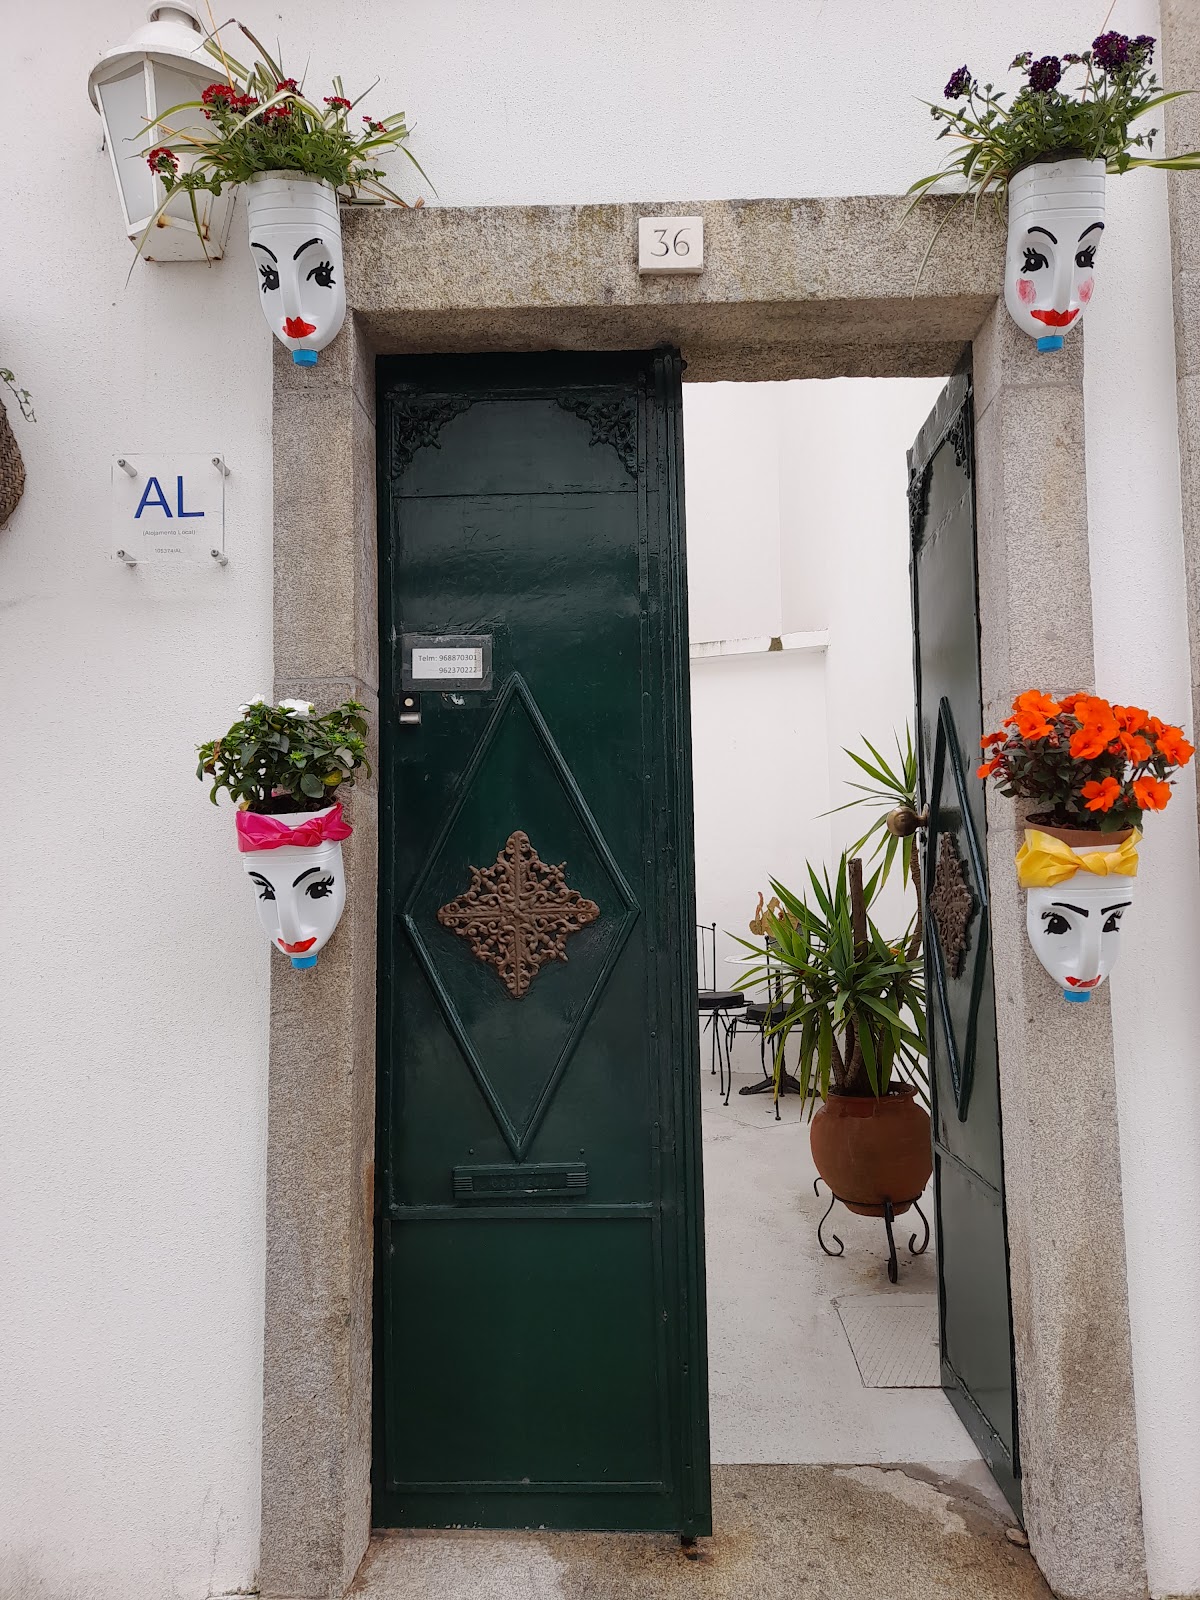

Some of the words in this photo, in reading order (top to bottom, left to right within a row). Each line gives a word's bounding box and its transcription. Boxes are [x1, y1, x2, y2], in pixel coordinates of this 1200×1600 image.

[650, 227, 692, 257] 36
[134, 475, 205, 518] AL
[418, 654, 438, 662] Telm:
[438, 654, 478, 662] 968870301
